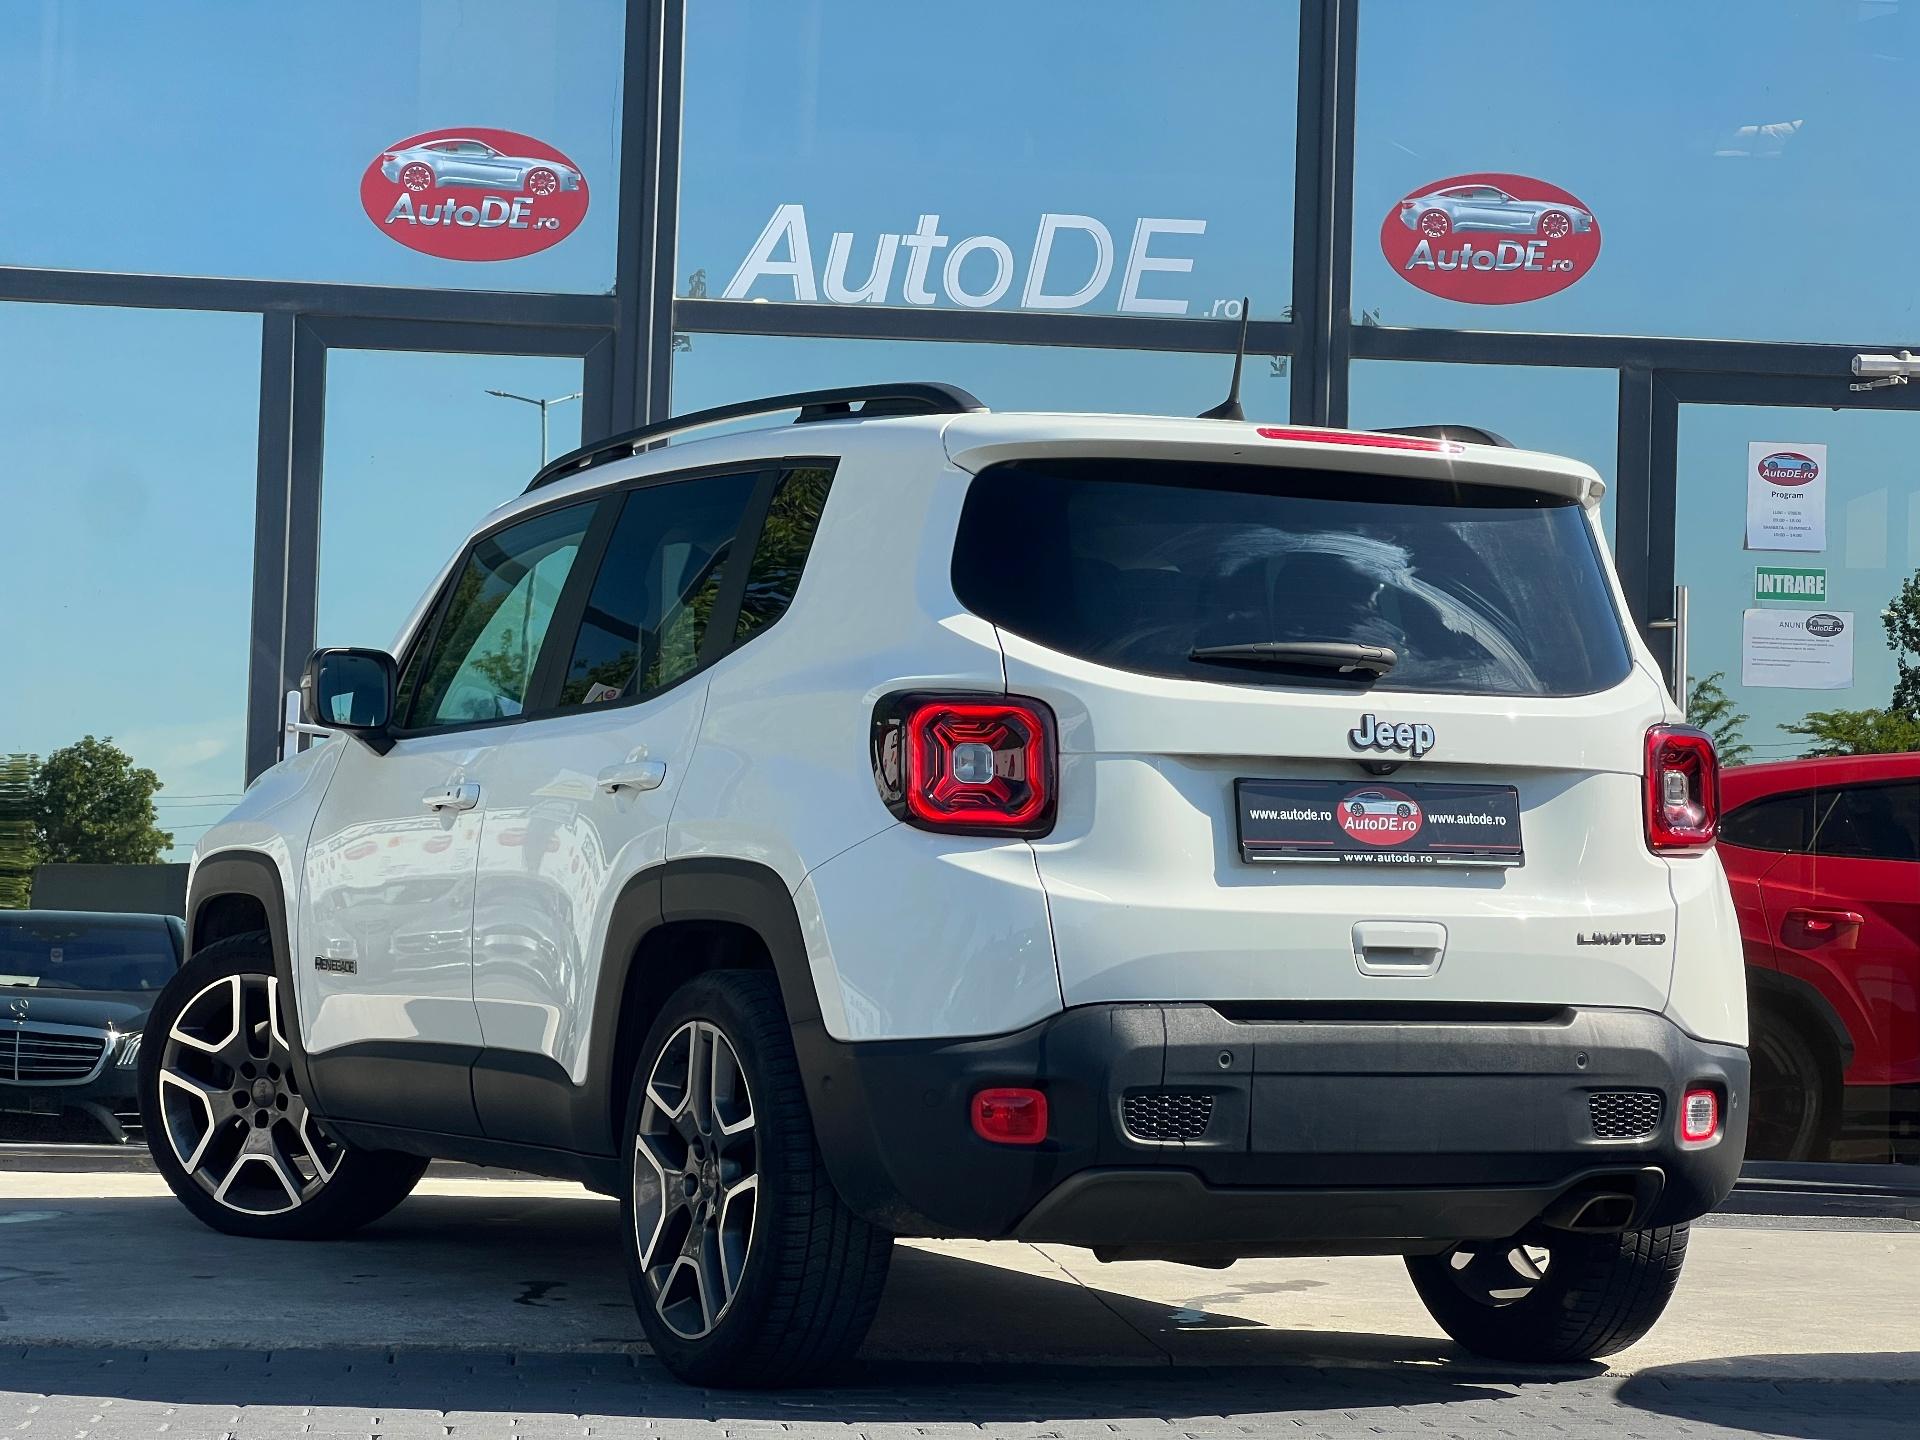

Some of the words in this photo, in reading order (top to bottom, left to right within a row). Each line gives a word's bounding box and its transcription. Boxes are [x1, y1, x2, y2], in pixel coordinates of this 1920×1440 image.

[1762, 468, 1815, 479] AutoDE.ro
[1771, 491, 1804, 500] Program
[1757, 573, 1825, 595] INTRARE
[1348, 713, 1435, 757] Jeep
[1250, 808, 1332, 821] www.autode.ro
[1343, 816, 1417, 832] AutoDE.ro
[1428, 813, 1507, 826] www.autode.ro
[1343, 853, 1433, 864] www.autode.ro
[1576, 932, 1667, 945] LIMITED
[314, 955, 357, 975] RENEGADE
